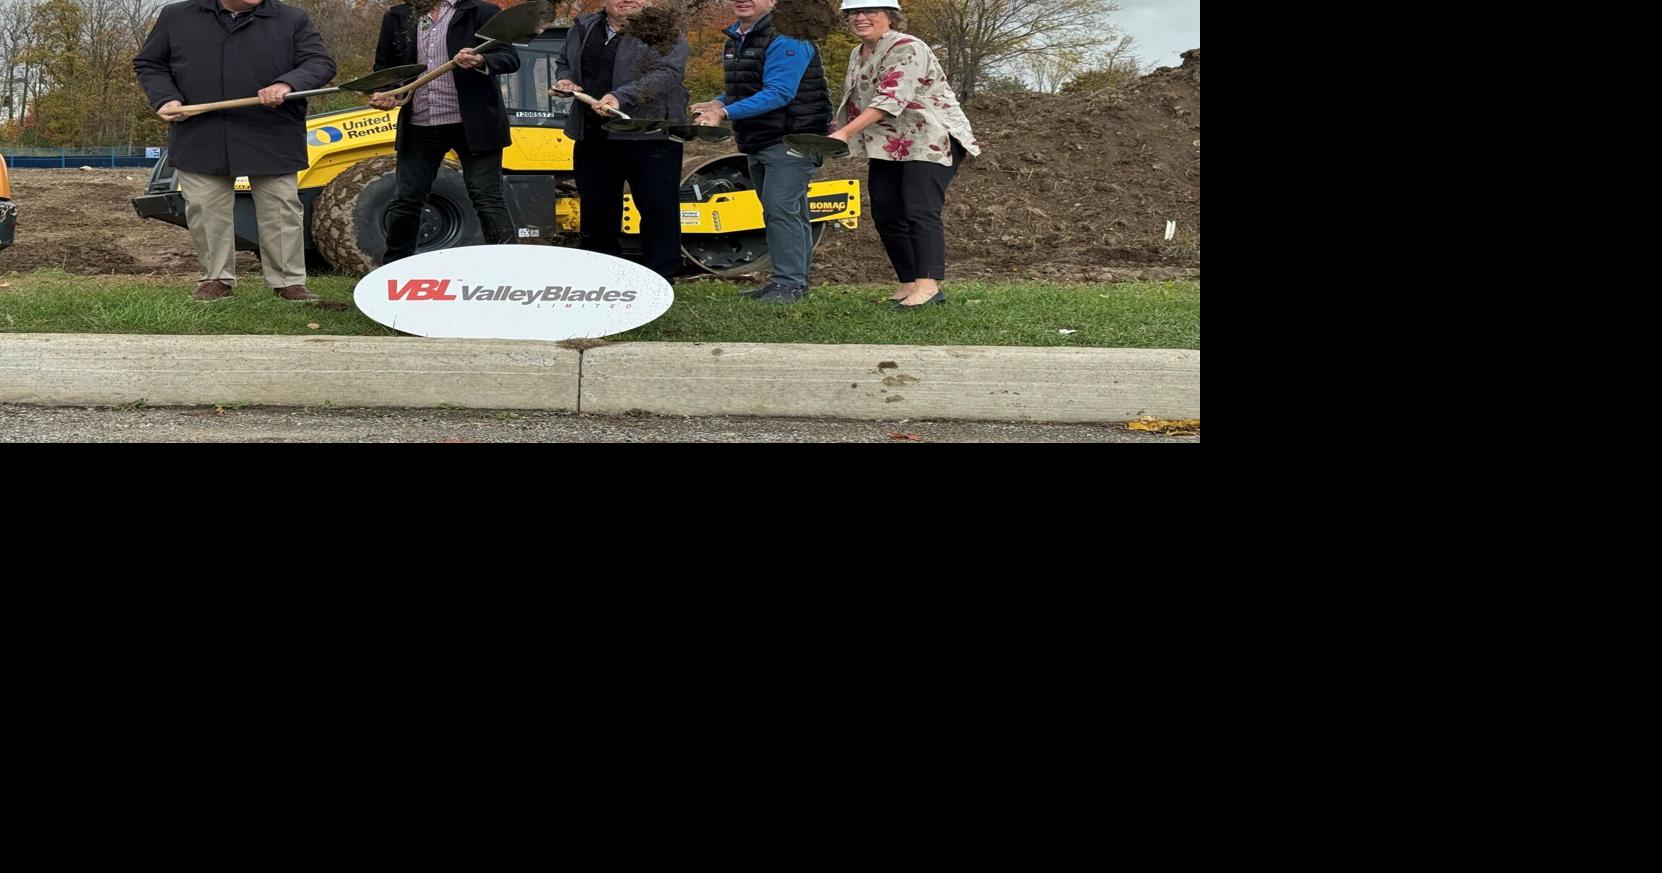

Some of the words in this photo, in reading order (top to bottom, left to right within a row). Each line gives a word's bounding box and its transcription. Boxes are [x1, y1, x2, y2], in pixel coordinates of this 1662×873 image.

[342, 113, 391, 131] United
[347, 122, 398, 139] Rentals
[809, 201, 846, 210] BOMAG
[387, 279, 457, 301] VBL
[461, 285, 637, 305] ValleyBlades
